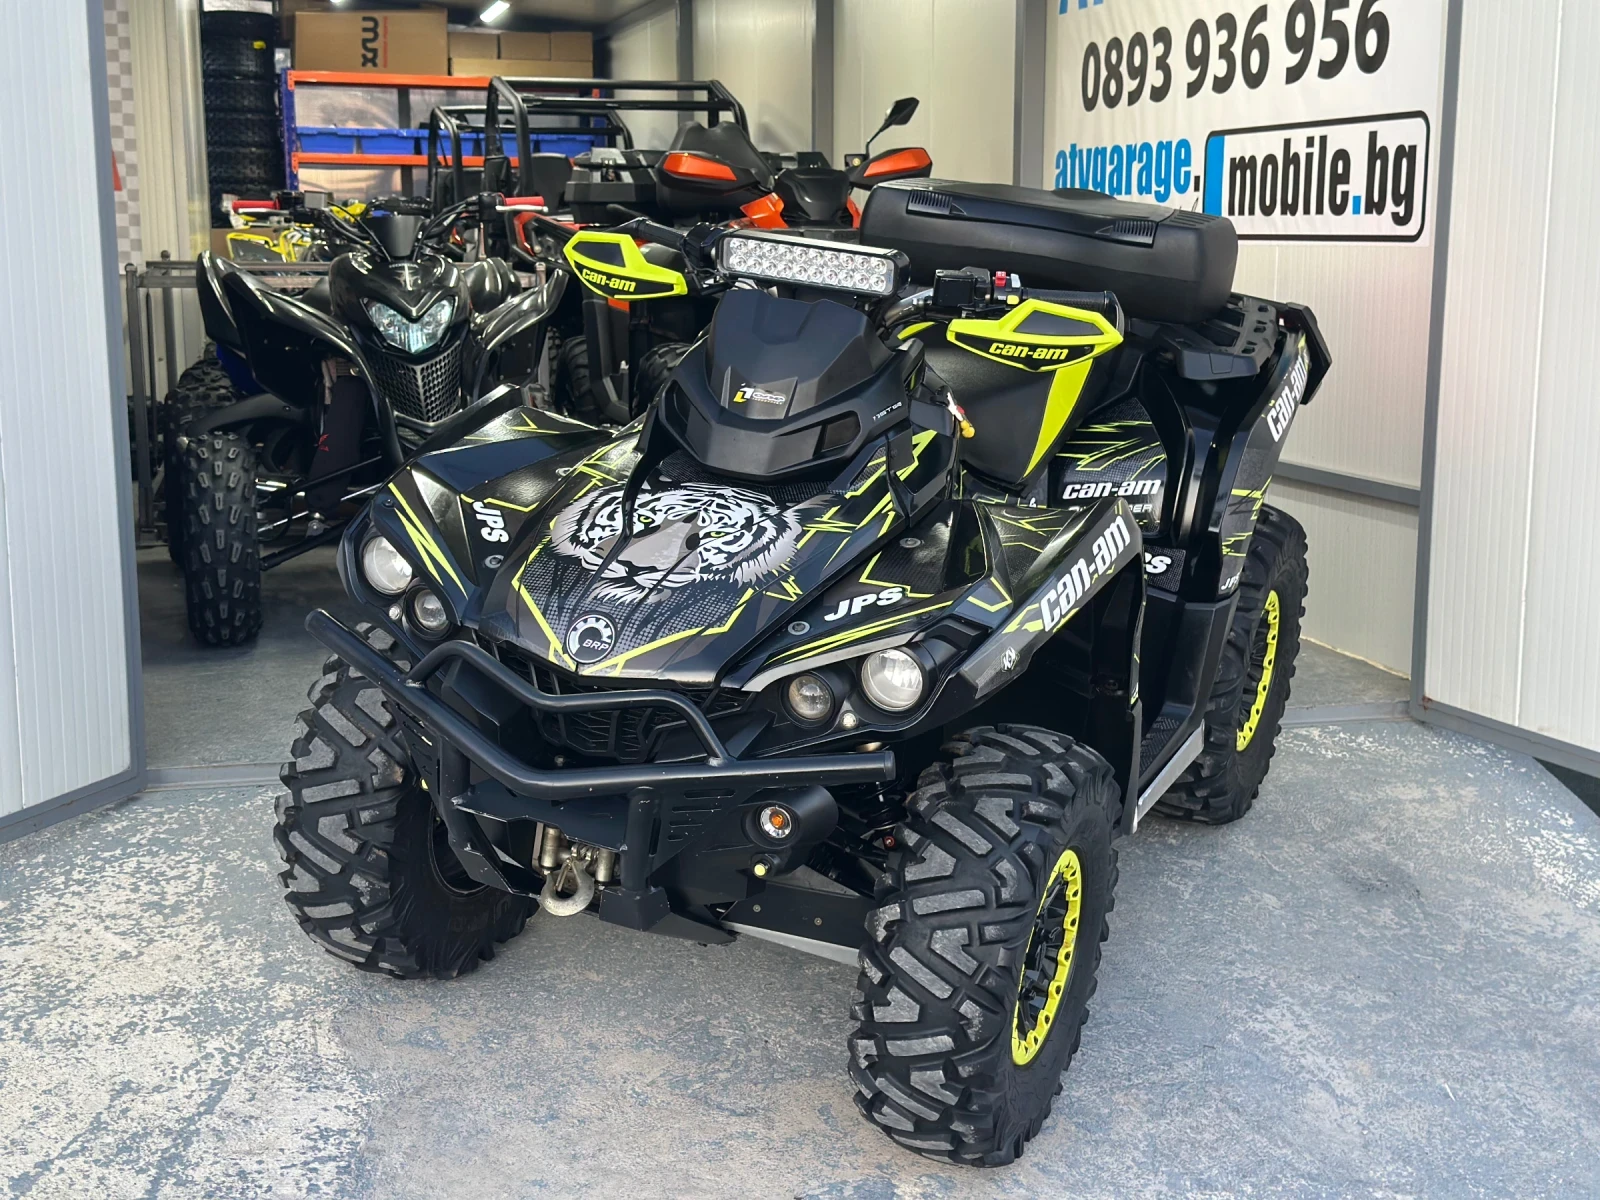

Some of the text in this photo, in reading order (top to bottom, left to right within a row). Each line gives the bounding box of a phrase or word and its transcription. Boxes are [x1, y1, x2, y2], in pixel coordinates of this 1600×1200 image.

[1081, 0, 1390, 112] 0893 936 956
[582, 268, 636, 292] can-am
[989, 342, 1069, 360] can-am
[1062, 479, 1161, 500] can-am
[472, 501, 509, 543] JPS
[1040, 515, 1131, 632] can-am
[824, 587, 903, 622] JPS
[582, 638, 609, 651] BRP
